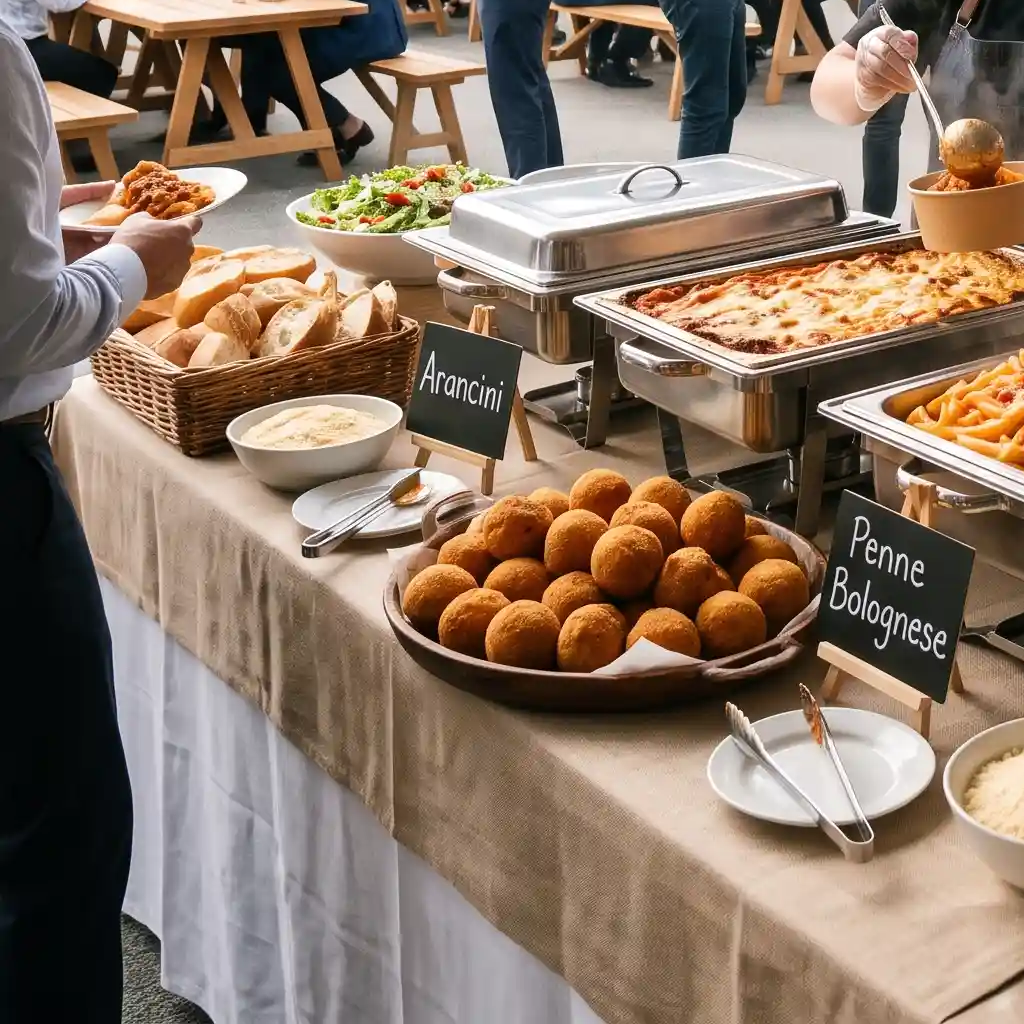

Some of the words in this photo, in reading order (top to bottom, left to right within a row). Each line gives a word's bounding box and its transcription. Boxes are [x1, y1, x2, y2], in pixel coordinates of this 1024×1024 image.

[419, 350, 504, 413] Arancini
[850, 515, 925, 588] Penne
[829, 566, 947, 659] Bolognese
